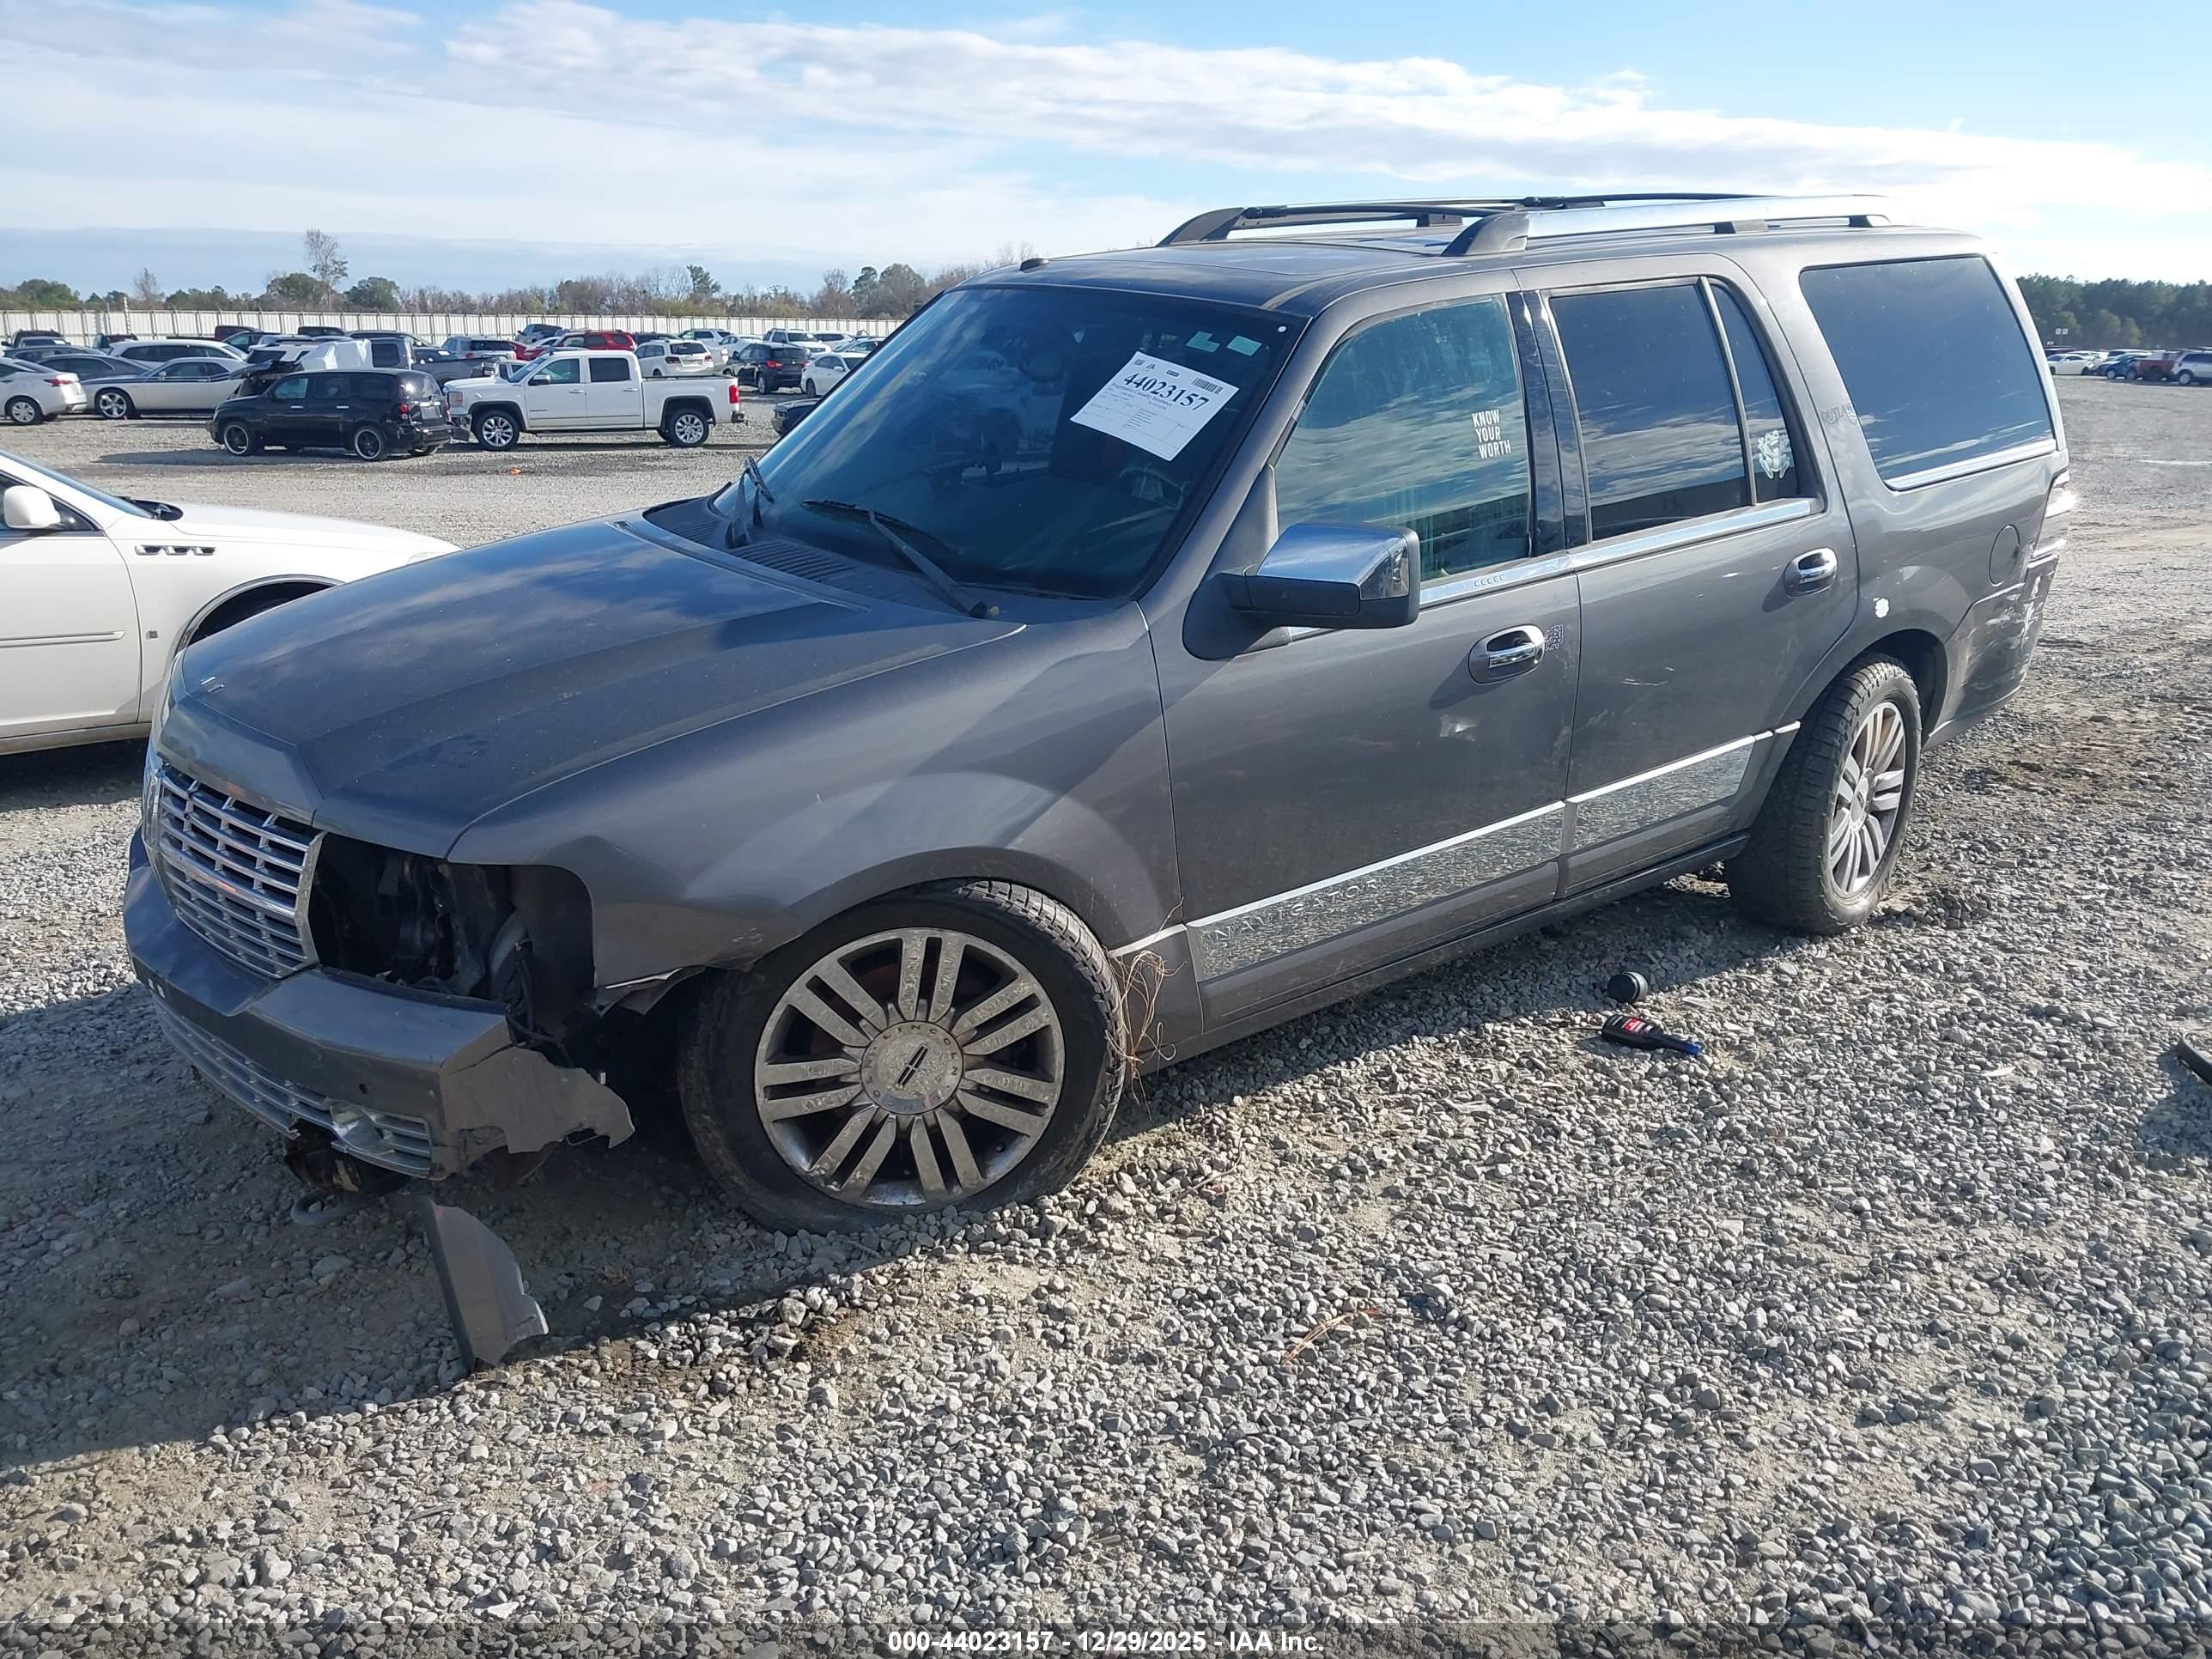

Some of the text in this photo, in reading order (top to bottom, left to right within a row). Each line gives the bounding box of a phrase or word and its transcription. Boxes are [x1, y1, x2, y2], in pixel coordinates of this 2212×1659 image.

[1123, 372, 1210, 411] 44023157
[1472, 409, 1500, 428] KNOW
[1475, 426, 1501, 443] YOUR
[1478, 439, 1511, 459] WORTH
[1214, 878, 1377, 942] NAVIGATOR
[882, 1024, 959, 1077] LINCOLN
